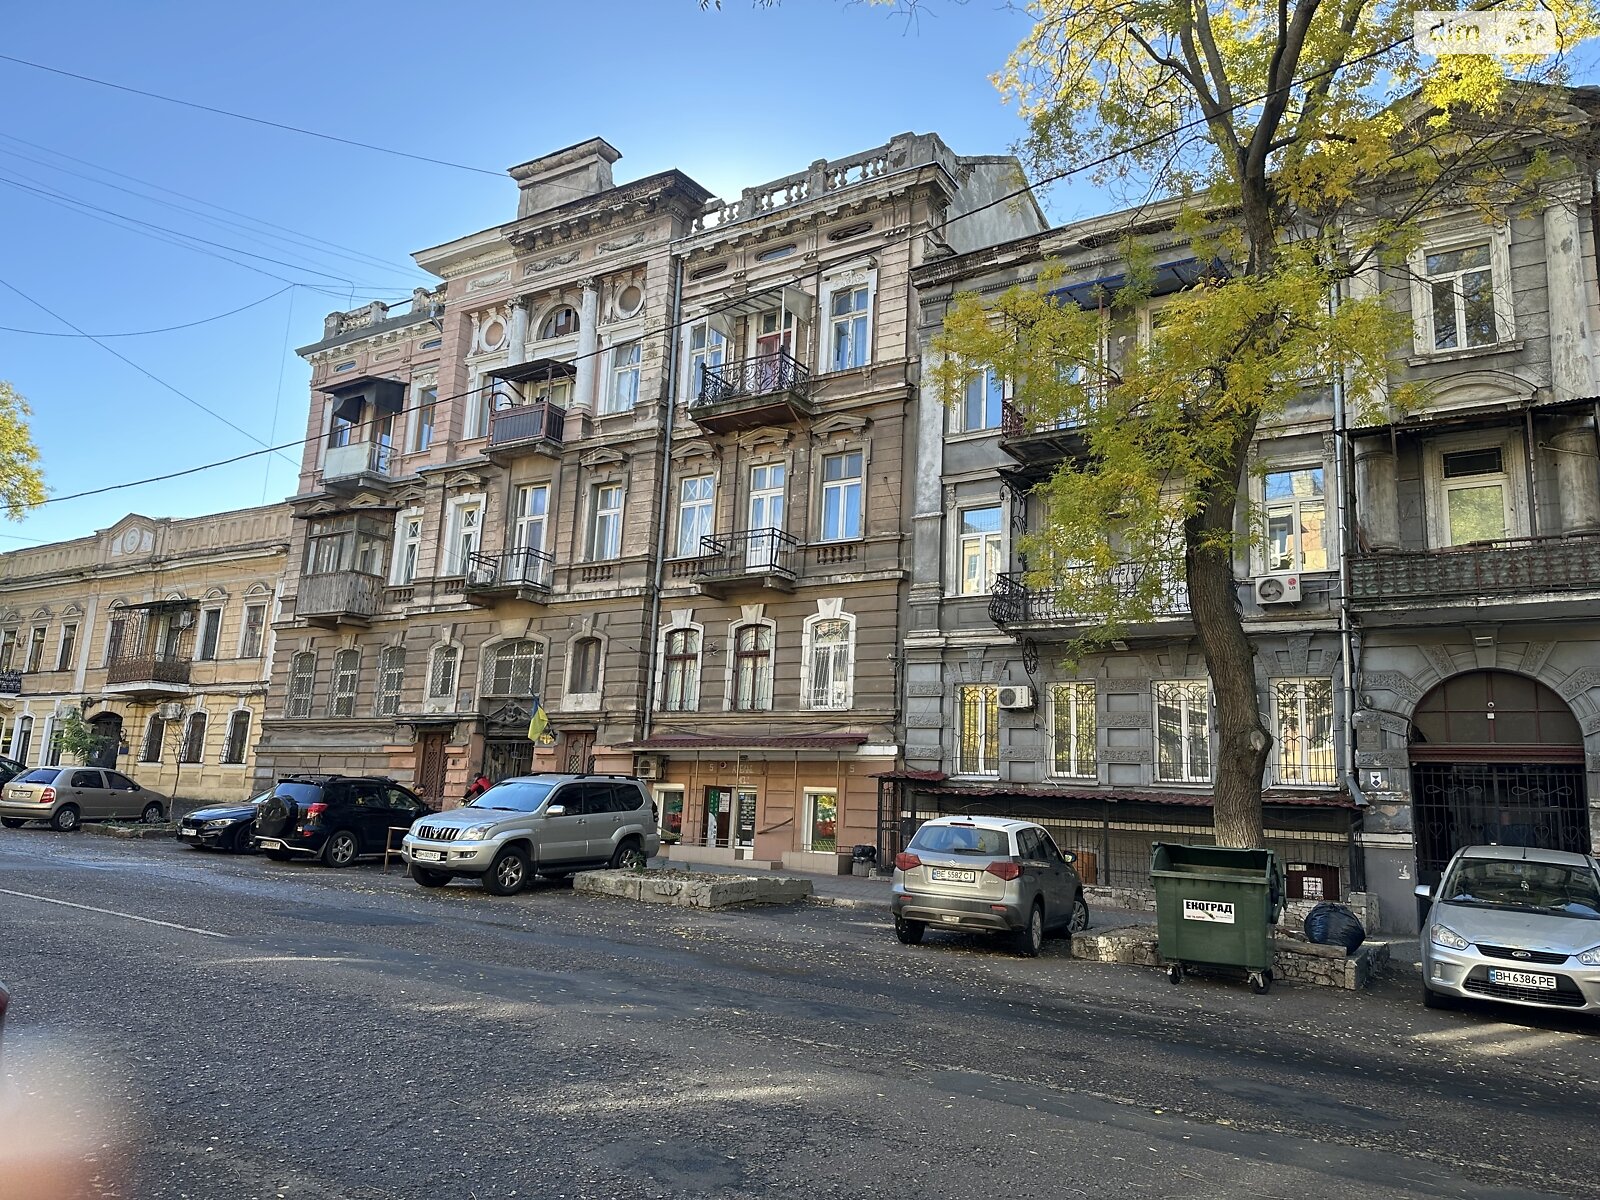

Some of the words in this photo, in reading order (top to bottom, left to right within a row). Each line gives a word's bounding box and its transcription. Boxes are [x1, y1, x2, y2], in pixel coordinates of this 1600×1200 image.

[937, 870, 946, 878] BE
[947, 871, 962, 879] 5582
[963, 872, 972, 880] CI
[1186, 901, 1233, 914] ЕКОГРАД
[1495, 971, 1511, 982] BH
[1512, 973, 1538, 985] 6386
[1538, 976, 1555, 987] PE
